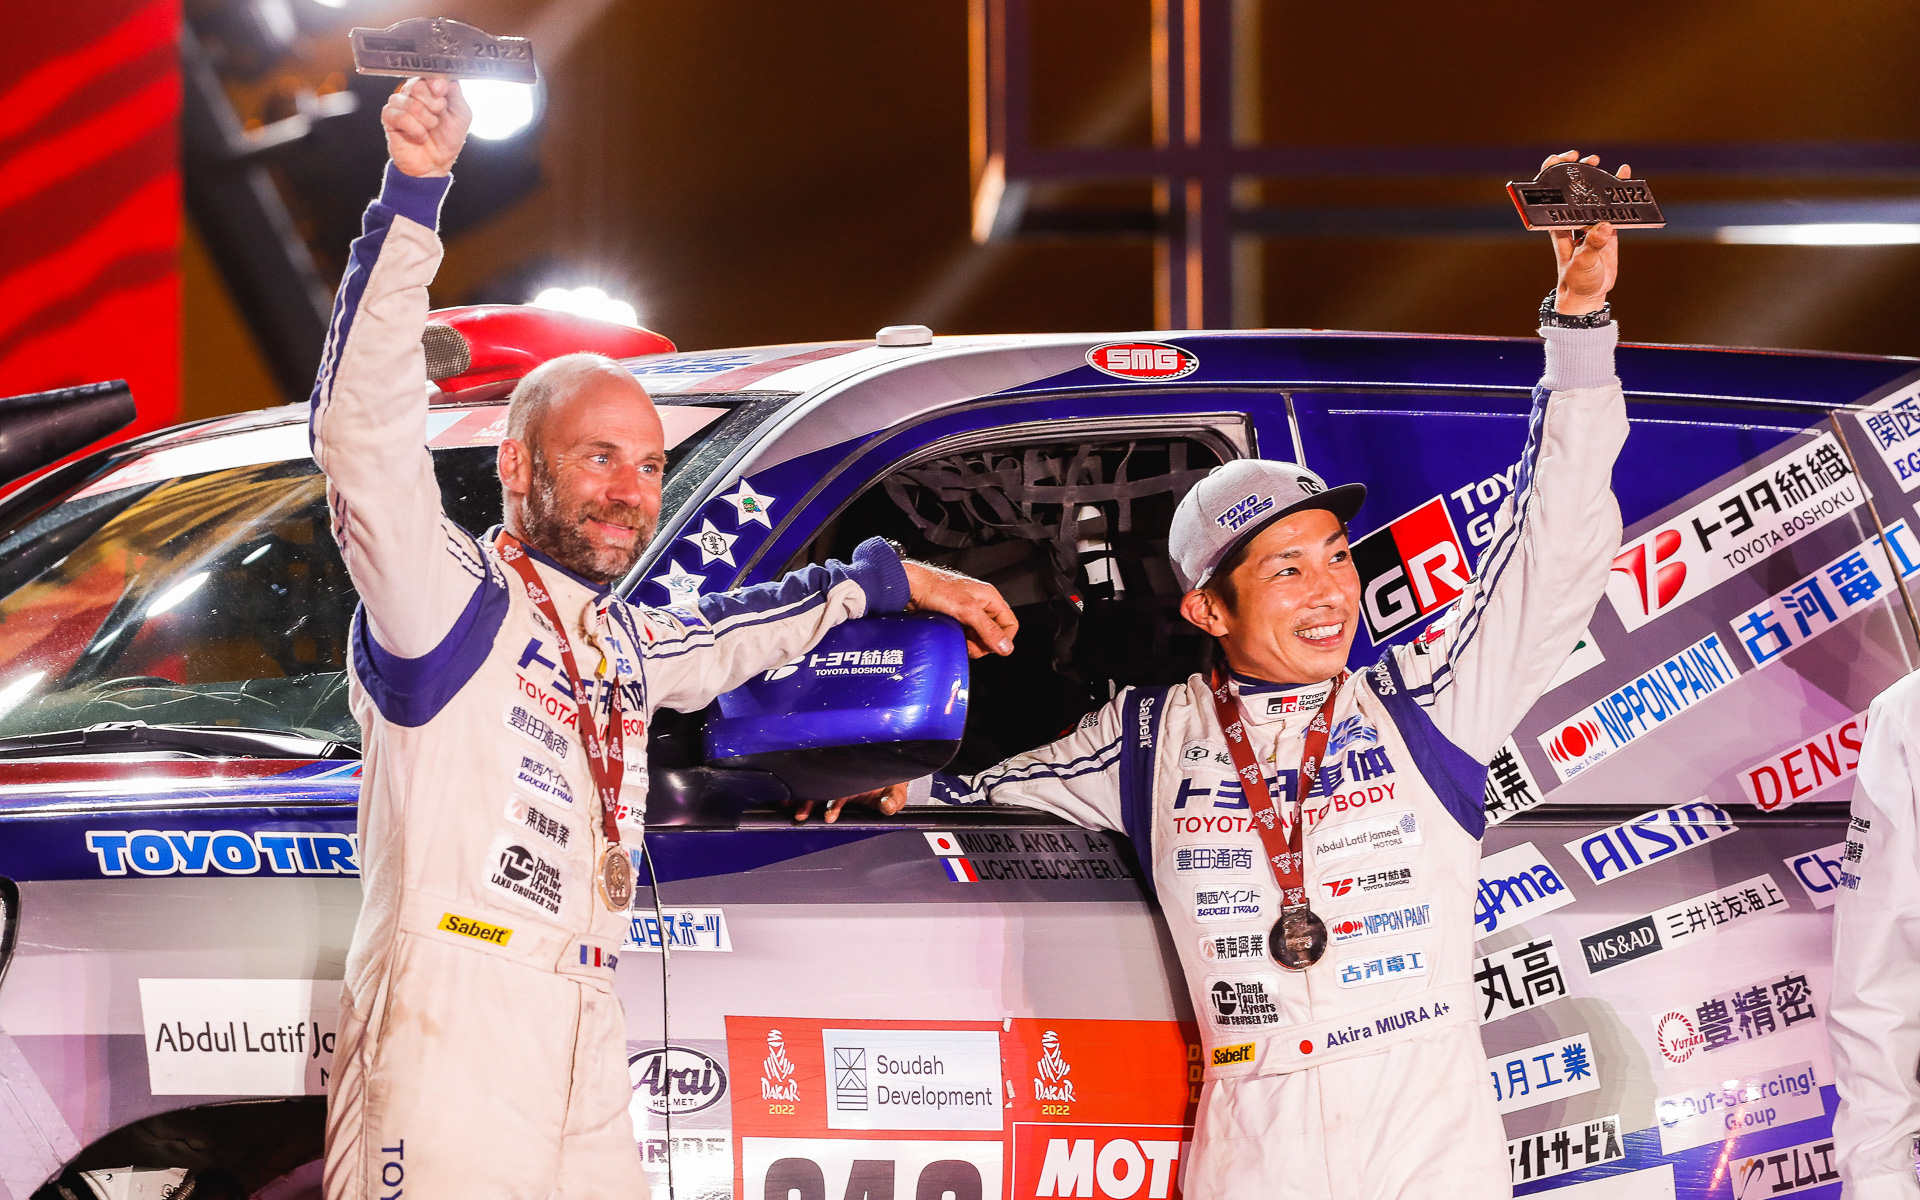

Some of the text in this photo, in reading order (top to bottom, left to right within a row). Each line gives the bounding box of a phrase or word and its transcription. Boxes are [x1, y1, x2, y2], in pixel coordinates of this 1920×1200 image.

[1604, 187, 1652, 204] 2022
[1548, 208, 1642, 222] SAUDI ARABIA
[1106, 349, 1178, 370] SMG
[1866, 389, 1920, 451] 関西
[1450, 460, 1522, 515] TOY
[1692, 443, 1853, 552] トヨタ紡織
[1216, 494, 1258, 527] TOYO
[1228, 497, 1274, 531] TIRES
[1466, 512, 1497, 547] G
[1722, 487, 1856, 569] TOYOTA BOSHOKU
[1365, 539, 1471, 632] GR
[1739, 524, 1920, 664] 古河電工
[809, 650, 904, 668] トヨタ紡織
[815, 666, 896, 676] TOYOTA BOSHOKU
[516, 673, 582, 731] TOYOTA
[1593, 635, 1734, 747] NIPPON PAINT
[1139, 698, 1155, 748] Sabelt
[1268, 701, 1297, 714] GR
[1749, 715, 1869, 810] DENS
[1484, 746, 1536, 820] 業
[1173, 816, 1258, 834] TOYOTA
[1333, 783, 1396, 812] BODY
[87, 830, 361, 875] TOYO TIR
[958, 833, 1019, 854] MIURA
[1020, 833, 1079, 854] AKIRA
[1316, 826, 1400, 855] Abdul Latif Jameel
[972, 859, 1114, 880] LICHTLEUCHTER
[1177, 848, 1252, 871] 豊田通商
[1197, 890, 1260, 905] 関西ペイント
[1197, 905, 1259, 917] EGUCHI IWAO
[1667, 883, 1784, 938] 三井住友海上
[445, 915, 506, 943] Sabelt
[1363, 904, 1430, 935] NIPPON PAINT
[1215, 934, 1263, 958] 東海興業
[1588, 926, 1656, 963] MS&AD
[1341, 952, 1424, 983] 古河電工
[1474, 939, 1566, 1021] 丸高
[1235, 982, 1263, 994] Thank
[1262, 1013, 1278, 1024] 200
[1326, 1002, 1451, 1048] Akira MIURA A+
[1696, 975, 1816, 1052] 豊精密
[155, 1022, 237, 1052] Abdul
[243, 1022, 305, 1053] Latif
[1671, 1034, 1704, 1051] YUTAKA
[877, 1055, 944, 1076] Soudah
[1213, 1045, 1252, 1065] Sabelt
[633, 1056, 716, 1096] Arai
[760, 1077, 800, 1102] DAKAR
[1034, 1077, 1076, 1103] DAKAR
[768, 1104, 795, 1115] 2022
[877, 1086, 993, 1110] Development
[1042, 1104, 1070, 1116] 2022
